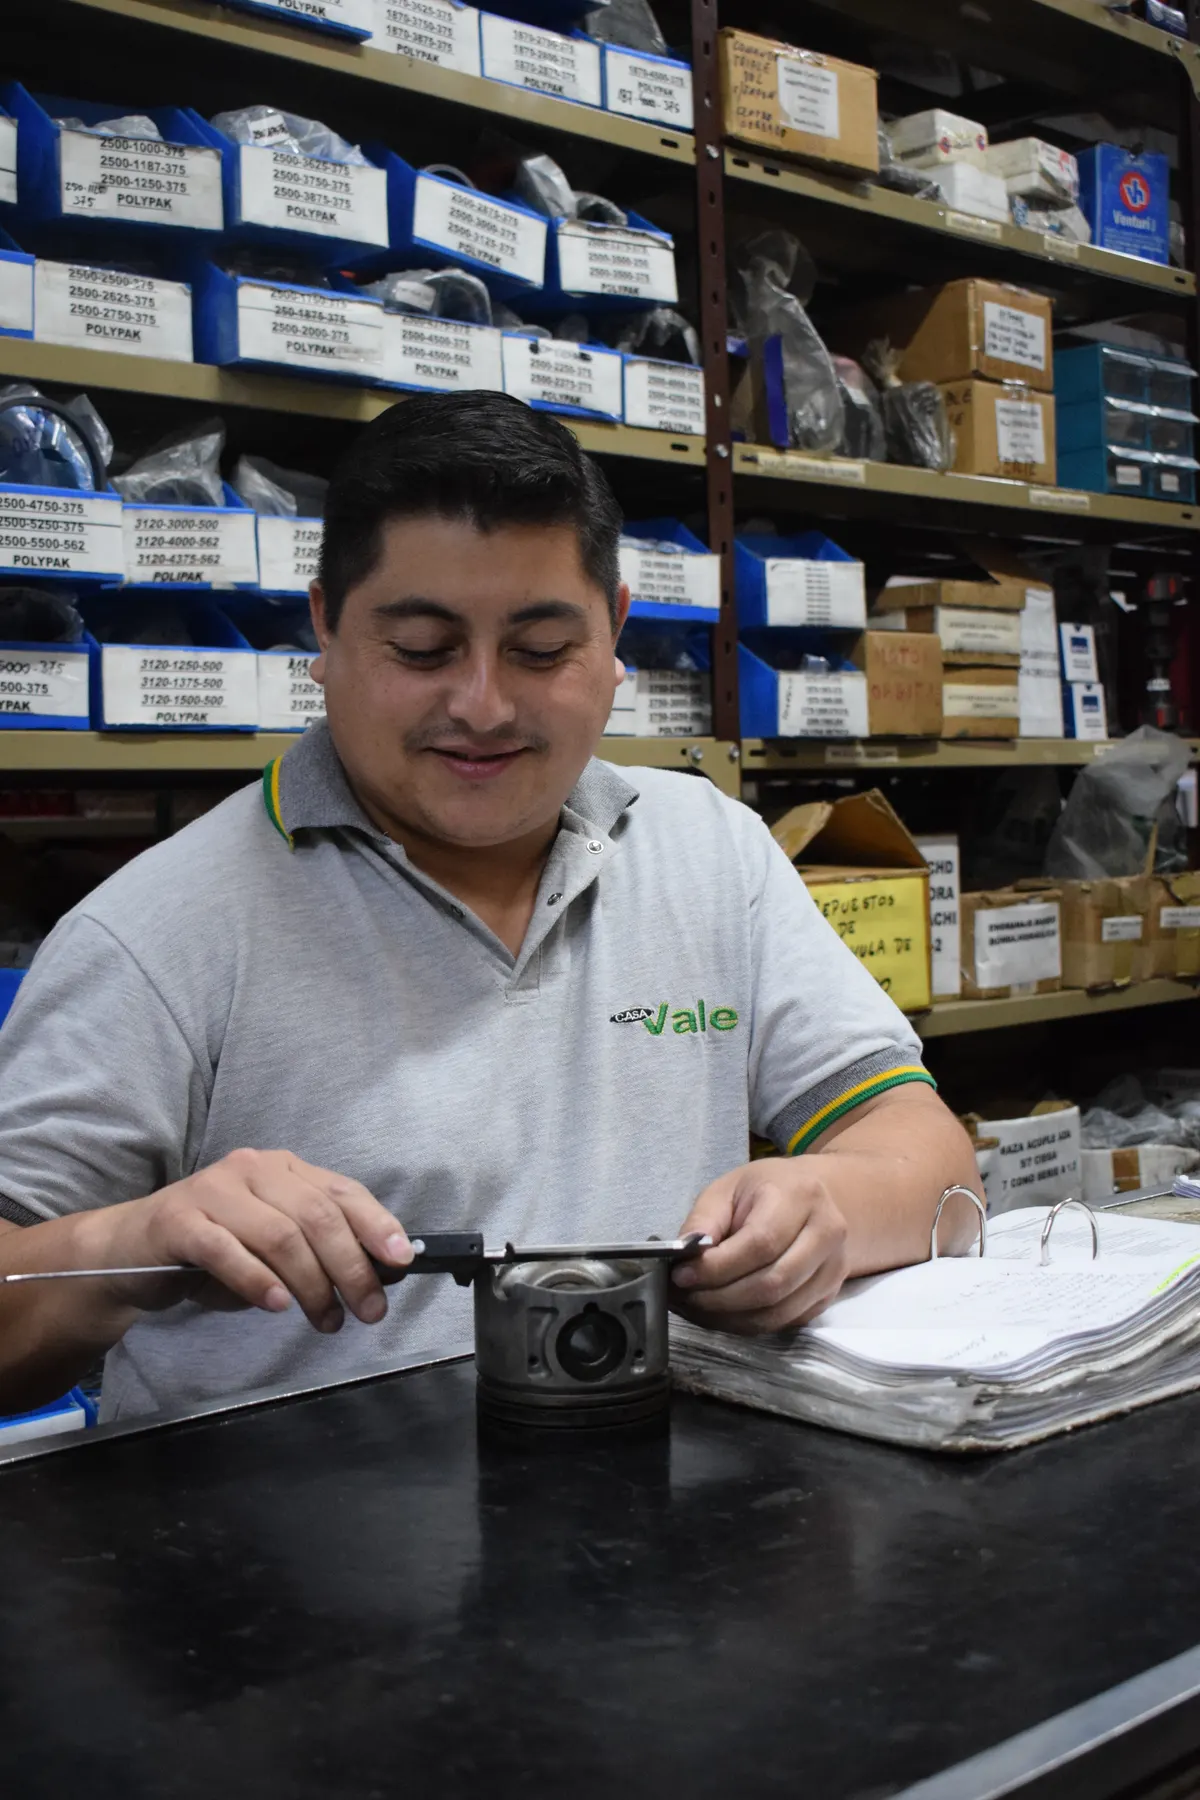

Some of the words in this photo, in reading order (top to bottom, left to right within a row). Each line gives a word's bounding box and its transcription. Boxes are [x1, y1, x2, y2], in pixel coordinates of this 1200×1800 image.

[397, 43, 440, 63] POLYPAK
[524, 76, 564, 94] POLYPAK
[100, 138, 185, 158] 2500-1000-375
[100, 155, 186, 175] 2500-1187-375
[101, 173, 187, 193] 2500-1250-375
[273, 169, 351, 193] 2500-3750-375
[117, 194, 172, 209] POLYPAK
[273, 186, 352, 209] 2500-3875-375
[286, 205, 337, 222] POLYPAK
[459, 242, 501, 266] POLYPAK
[68, 268, 154, 290] 2500-2500-375
[69, 285, 155, 308] 2500-2625-375
[70, 303, 156, 325] 2500-2750-375
[86, 323, 141, 340] POLYPAK
[286, 341, 336, 355] POLYPAK
[415, 363, 458, 377] POLYPAK
[541, 390, 581, 404] POLYPAK
[135, 518, 219, 530] 3120-3000-500
[136, 536, 219, 547] 3120-4000-562
[13, 555, 71, 568] POLYPAK
[141, 659, 223, 671] 3120-1250-500
[141, 677, 223, 688] 3120-1375-500
[142, 694, 224, 706] 3120-1500-500
[156, 712, 208, 722] POLYPAK
[930, 912, 957, 926] CHI
[615, 1009, 649, 1022] CASA
[643, 1000, 738, 1035] Vale
